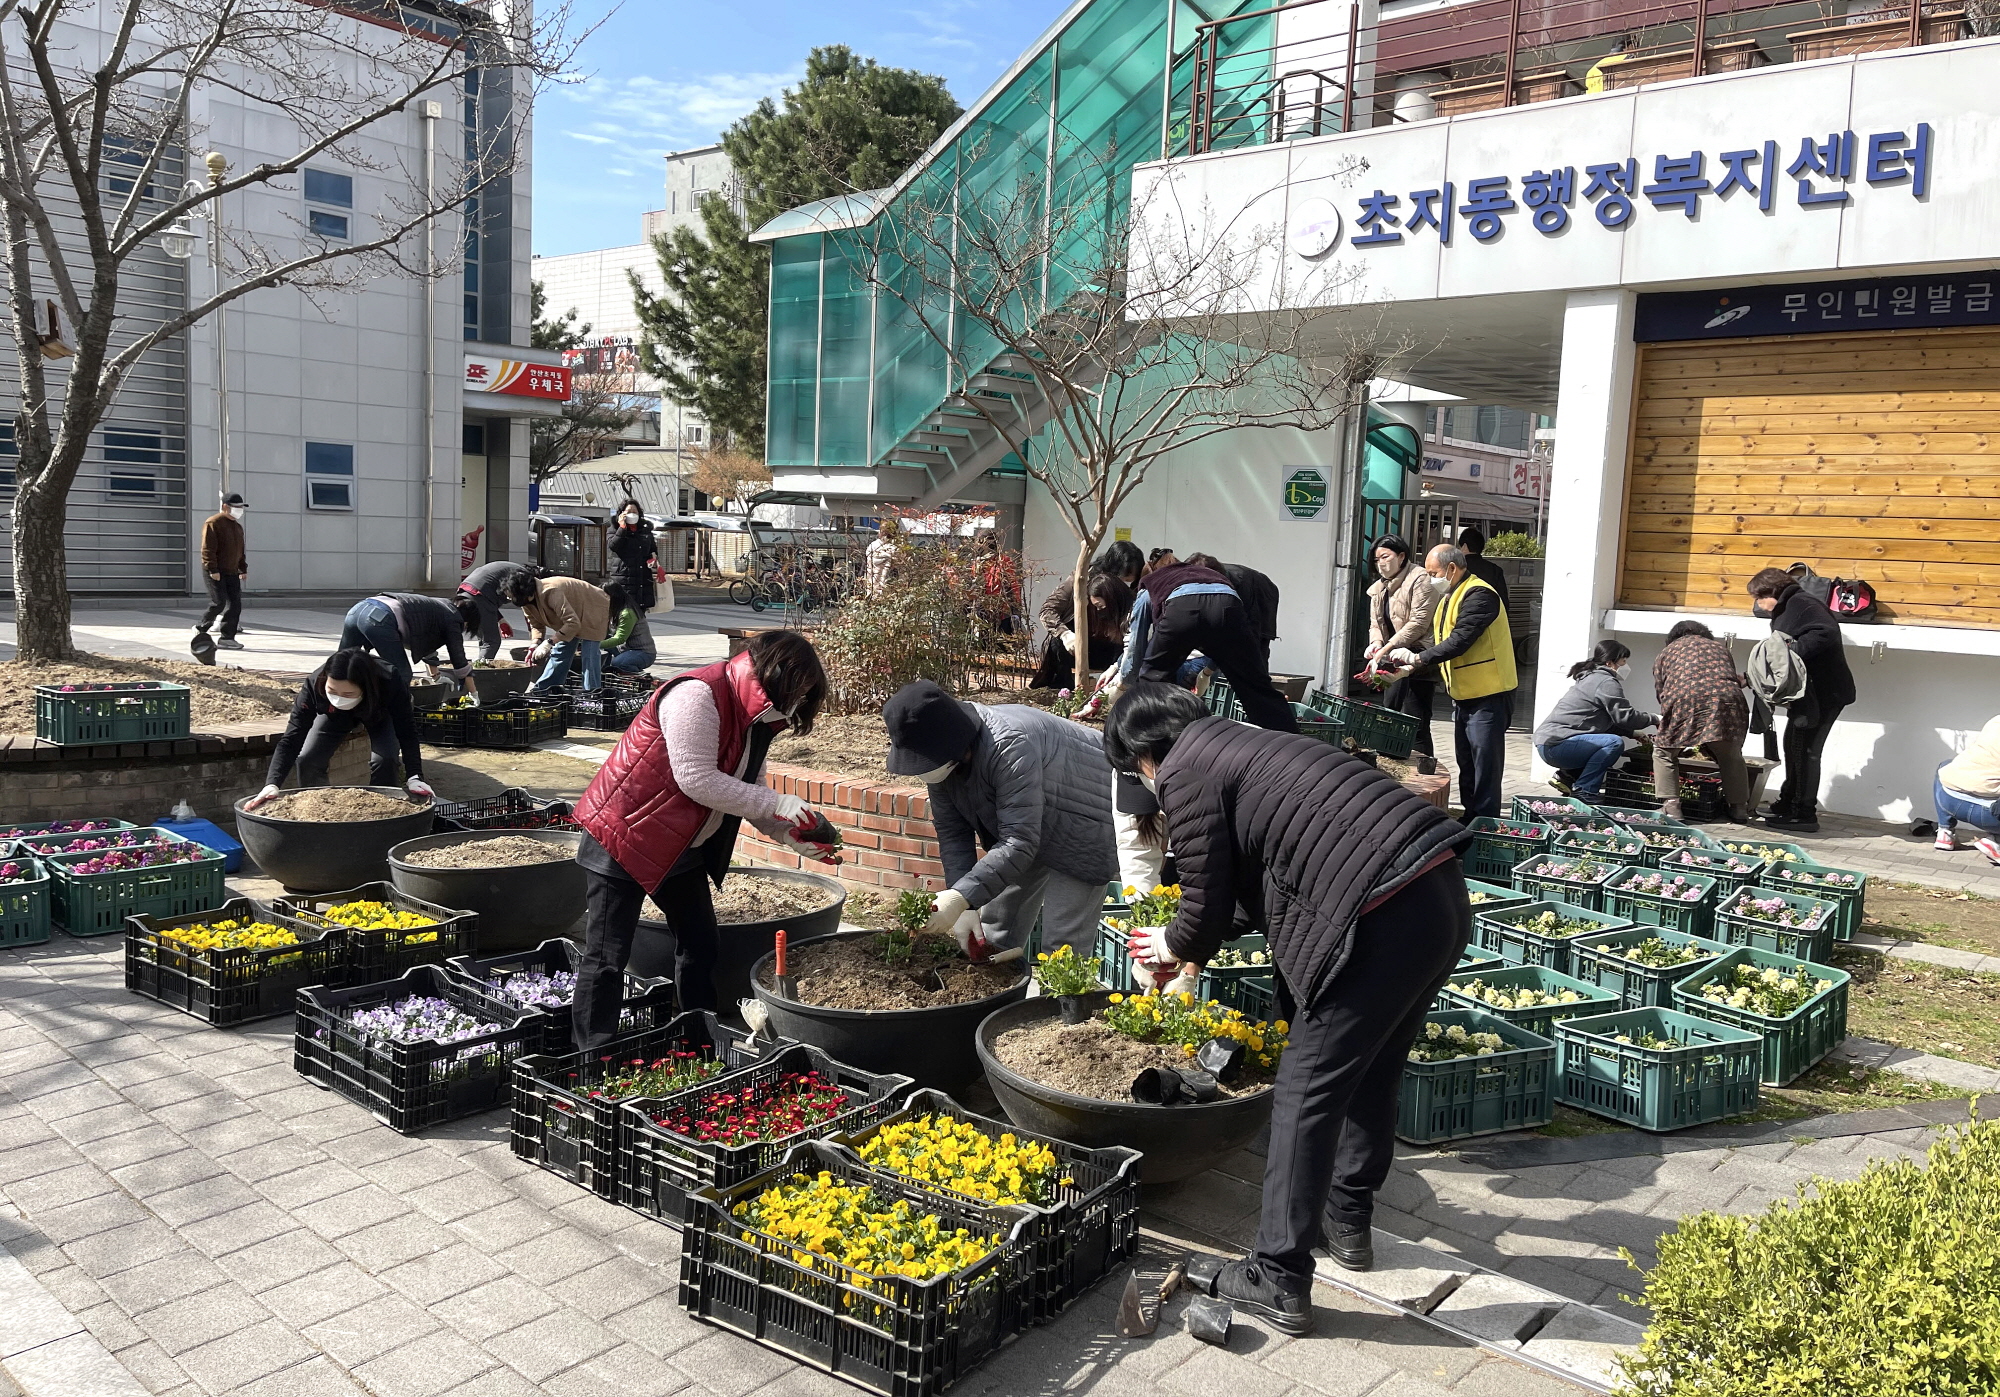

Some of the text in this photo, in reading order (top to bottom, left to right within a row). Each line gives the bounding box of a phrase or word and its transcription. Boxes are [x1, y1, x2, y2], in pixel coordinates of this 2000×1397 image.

[1351, 122, 1931, 244] 초지동행정복지센터
[1781, 282, 1994, 322] 무인민원발급
[529, 377, 564, 393] 우체국
